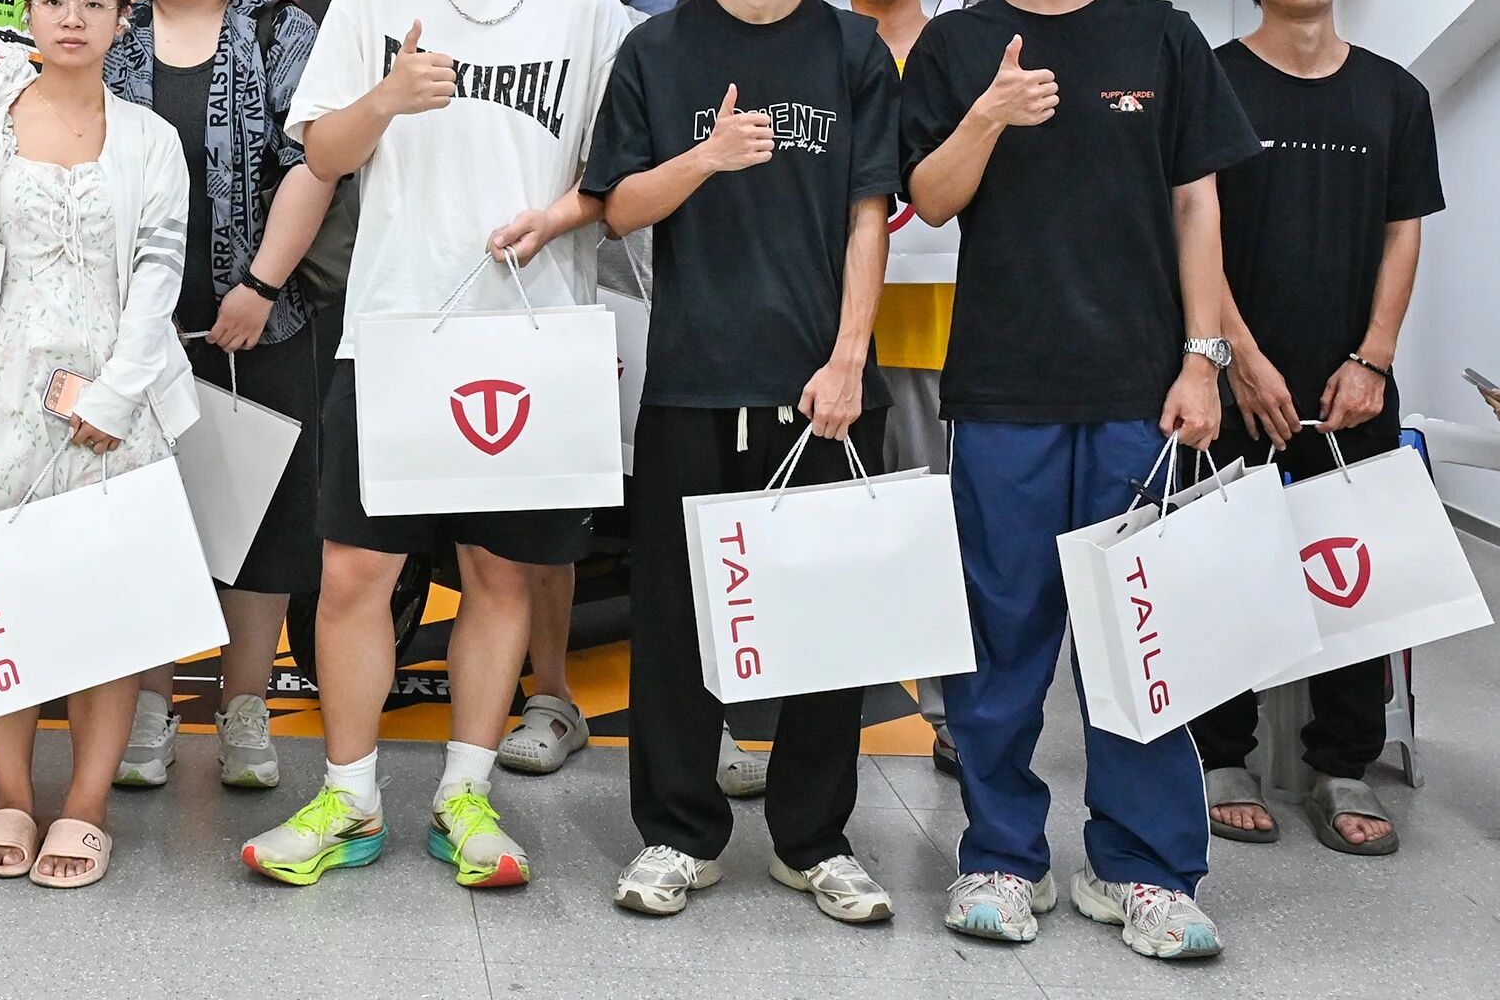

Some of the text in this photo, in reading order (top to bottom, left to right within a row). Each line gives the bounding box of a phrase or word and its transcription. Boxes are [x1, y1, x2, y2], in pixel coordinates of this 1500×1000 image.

[1100, 91, 1125, 99] PUPPY
[694, 103, 837, 143] MENT
[795, 138, 808, 149] the
[718, 520, 762, 681] TAILG
[1125, 556, 1170, 715] TAILG
